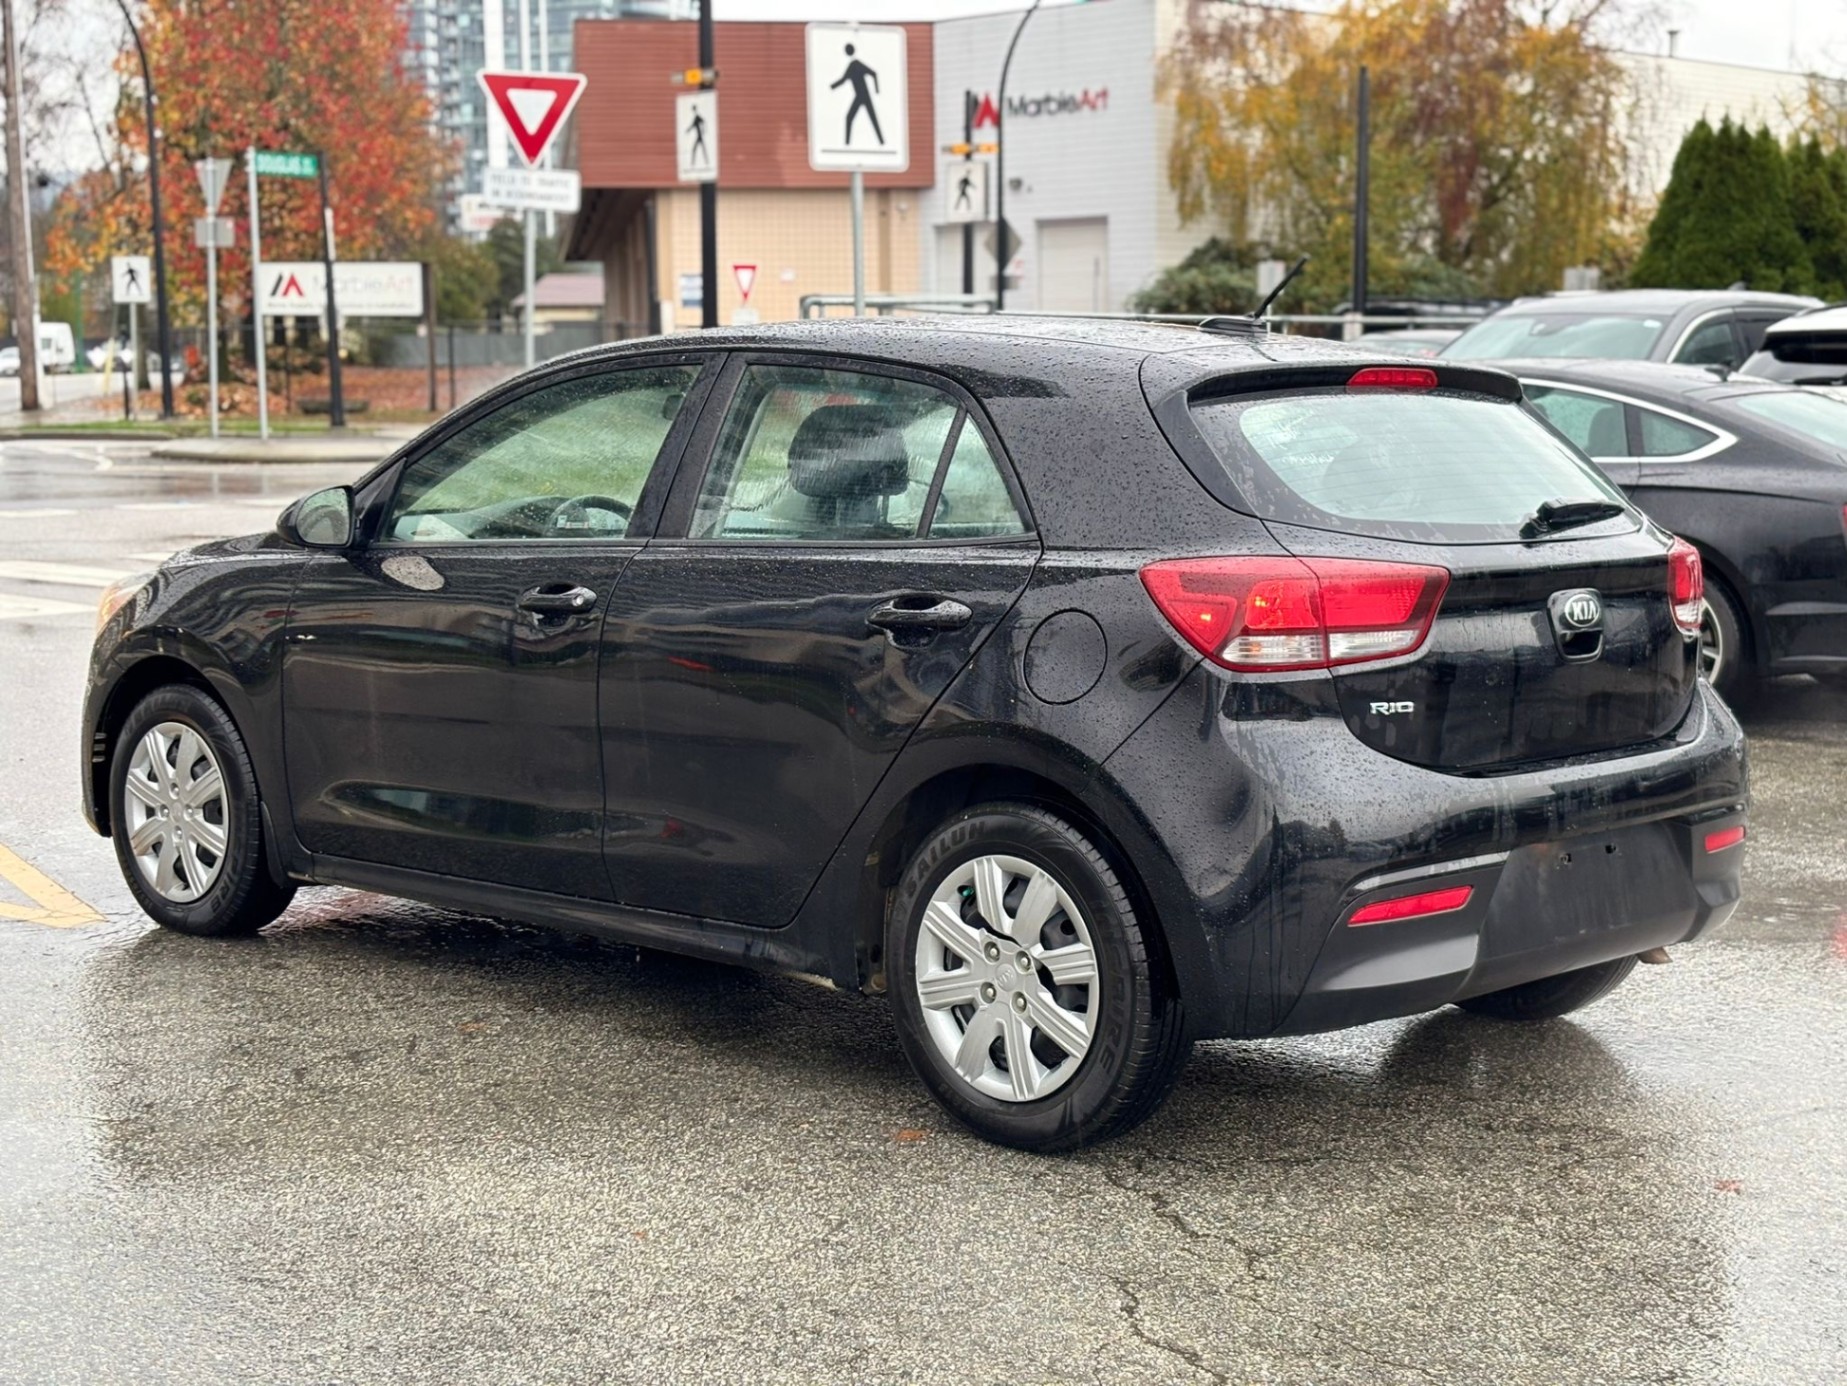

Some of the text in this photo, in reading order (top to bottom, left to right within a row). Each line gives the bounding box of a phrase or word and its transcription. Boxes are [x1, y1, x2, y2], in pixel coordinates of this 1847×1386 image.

[1007, 88, 1109, 116] MarbleArt
[1571, 600, 1596, 621] KIA
[1369, 701, 1415, 715] RIO
[905, 820, 985, 897] SAILUN
